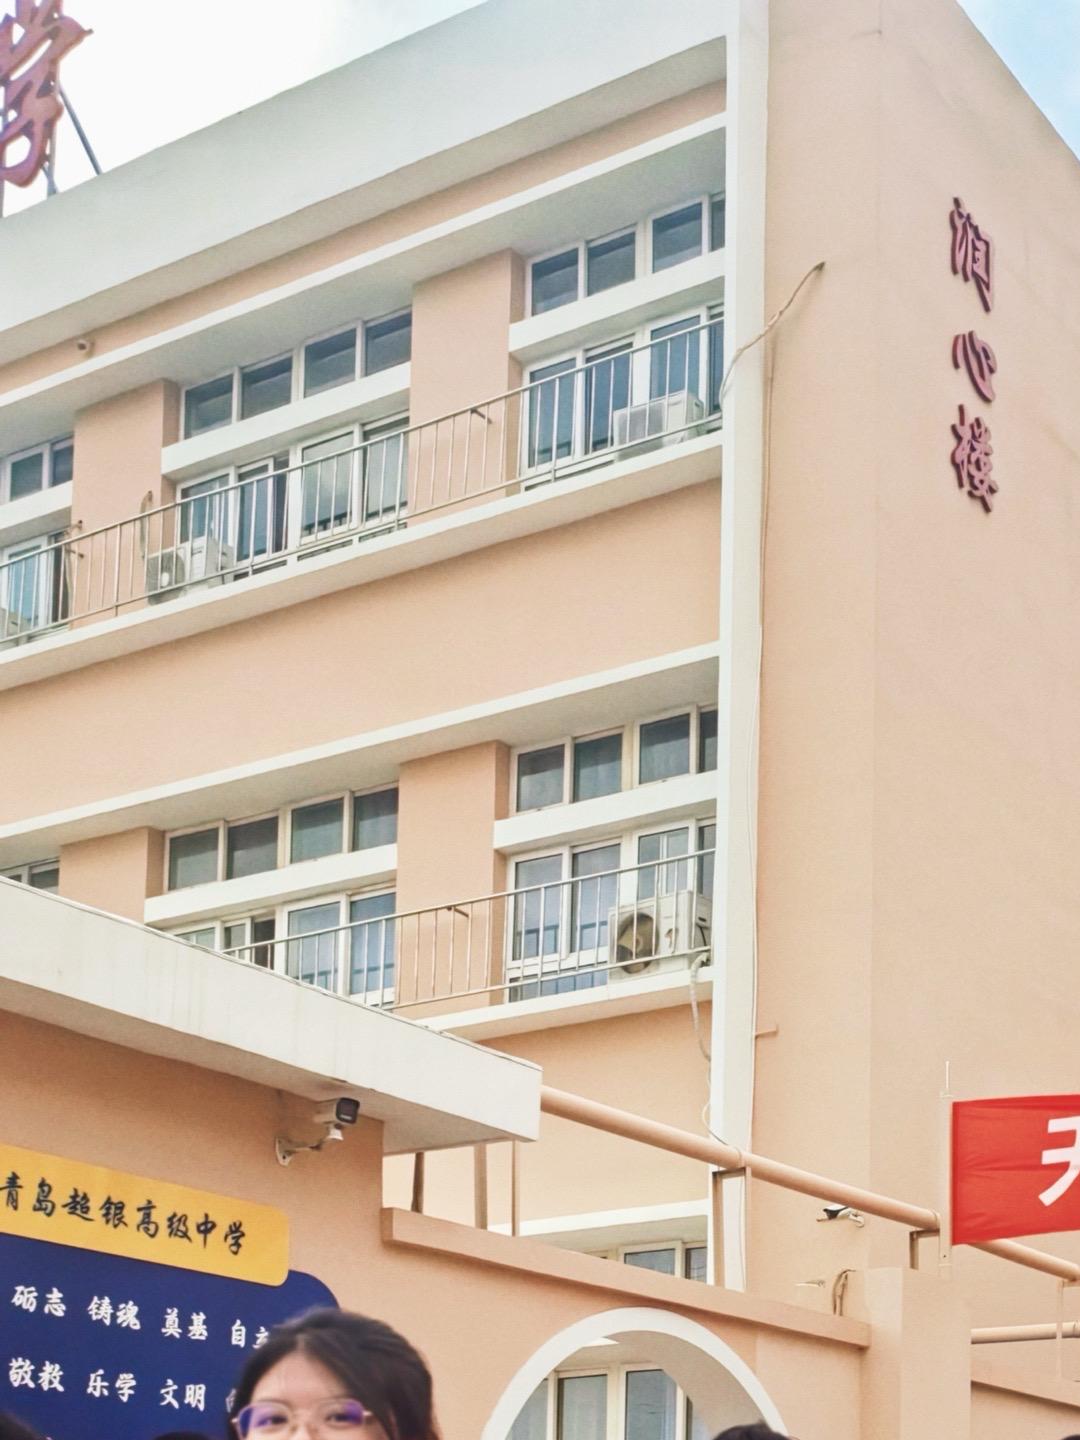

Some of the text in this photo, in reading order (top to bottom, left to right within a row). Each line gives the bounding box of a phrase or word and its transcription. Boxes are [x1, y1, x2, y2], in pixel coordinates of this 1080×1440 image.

[0, 1171, 246, 1255] 青岛超银高级中学
[11, 1285, 67, 1317] 砺志
[87, 1296, 141, 1330] 铸魂
[161, 1307, 208, 1340] 奠基
[8, 1357, 65, 1392] 敬教
[86, 1369, 137, 1403] 乐学
[160, 1379, 206, 1411] 文明
